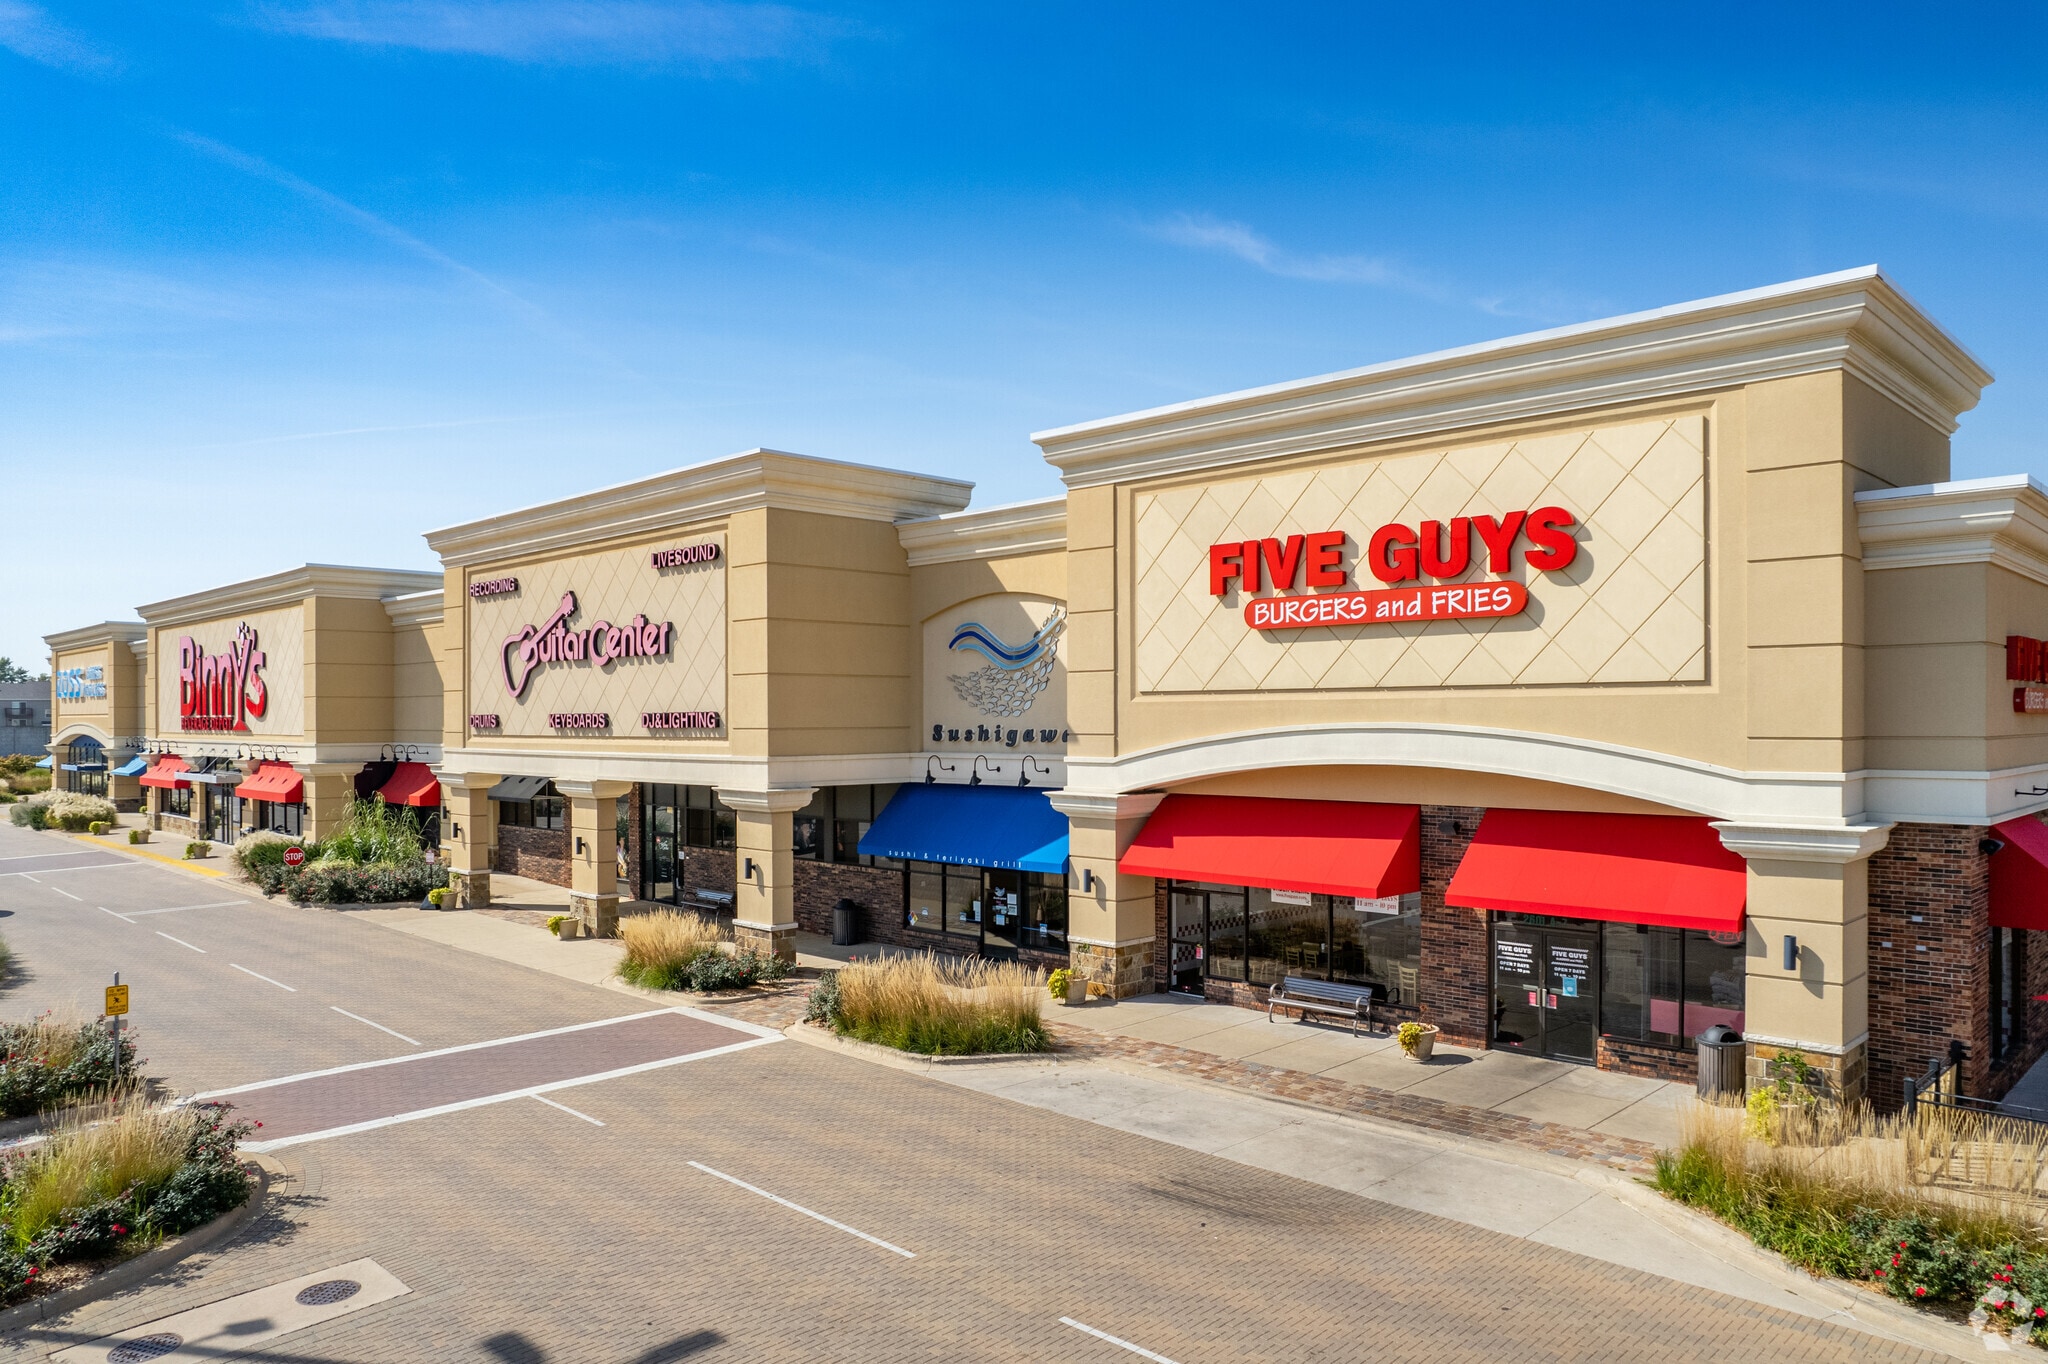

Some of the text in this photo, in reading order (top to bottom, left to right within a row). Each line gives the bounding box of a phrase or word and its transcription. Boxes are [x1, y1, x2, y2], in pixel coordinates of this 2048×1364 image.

[1209, 506, 1579, 596] FIVE GUYS
[470, 577, 518, 597] RECORDING
[1254, 586, 1513, 626] BURGERS and FRIES
[470, 714, 499, 728] DRUMS
[549, 713, 608, 728] KEYBOARDS
[888, 849, 916, 858] sushi
[936, 854, 985, 865] teriyaki
[993, 860, 1022, 869] grill
